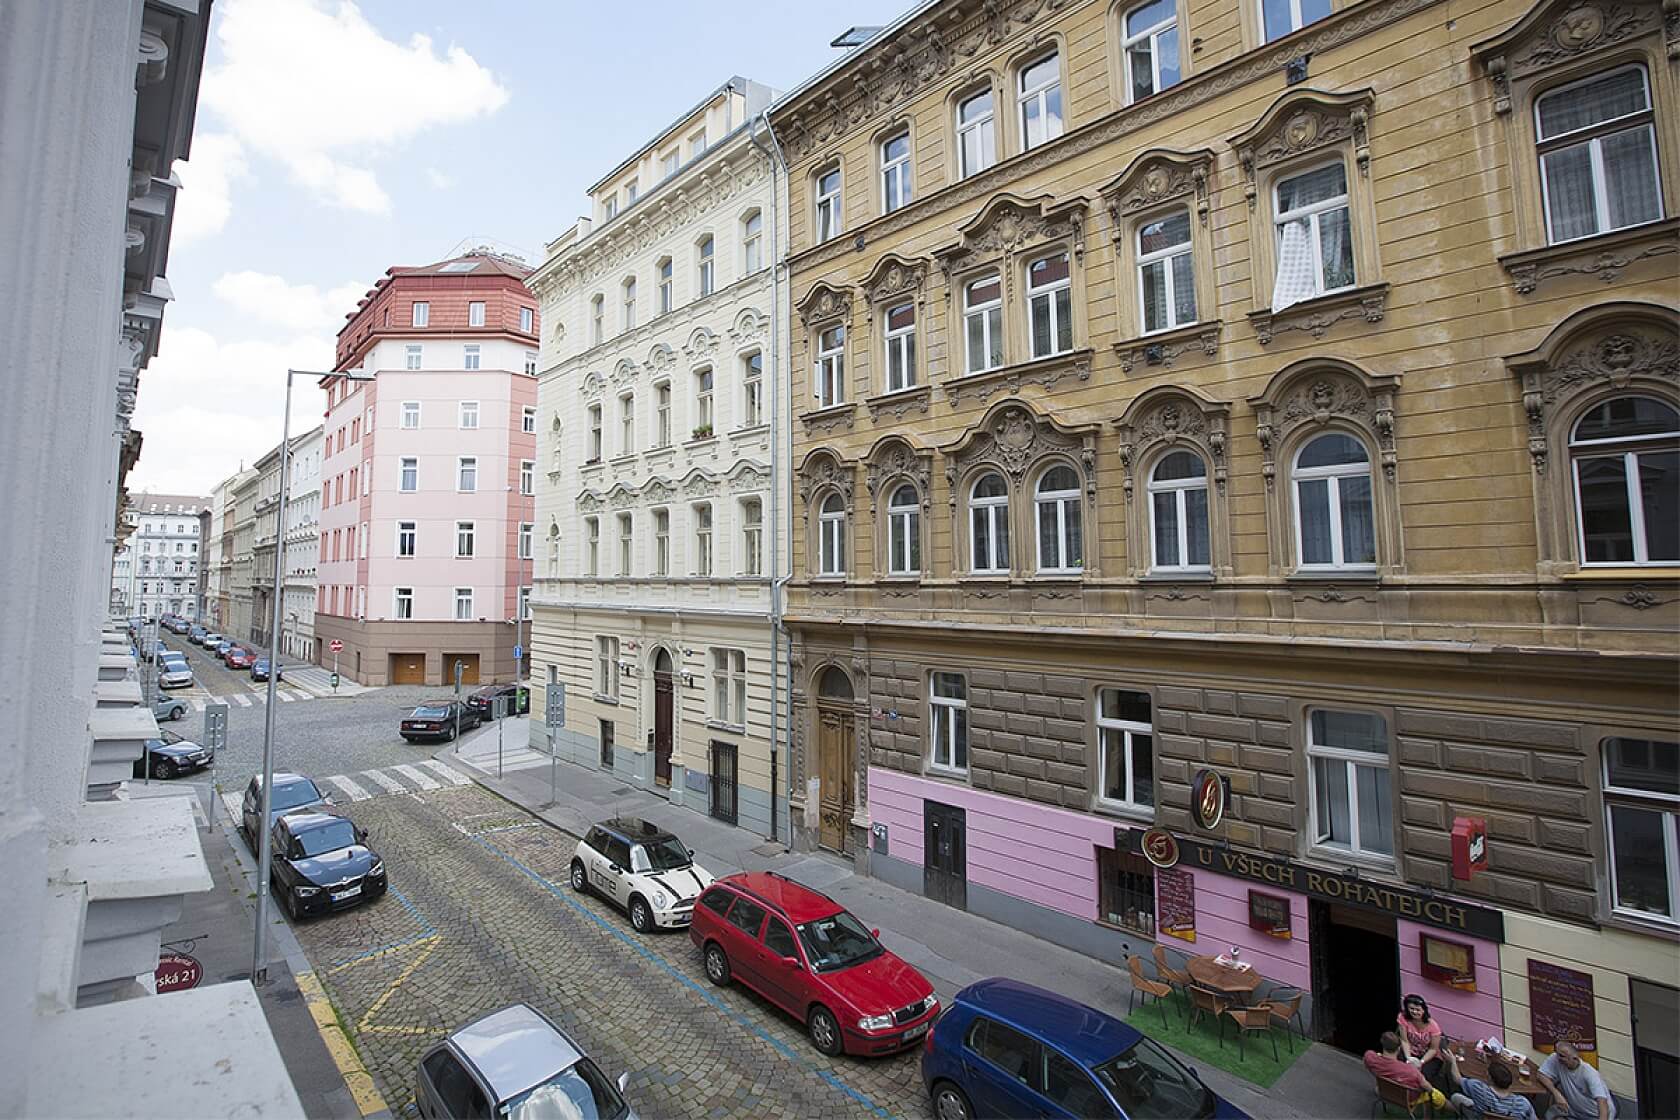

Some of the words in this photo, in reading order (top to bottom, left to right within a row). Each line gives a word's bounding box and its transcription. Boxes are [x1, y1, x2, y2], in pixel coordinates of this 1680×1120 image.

[1198, 847, 1214, 865] U
[1222, 853, 1296, 886] VŠECH
[1306, 872, 1467, 928] ROHATEJCH
[182, 969, 196, 983] 21
